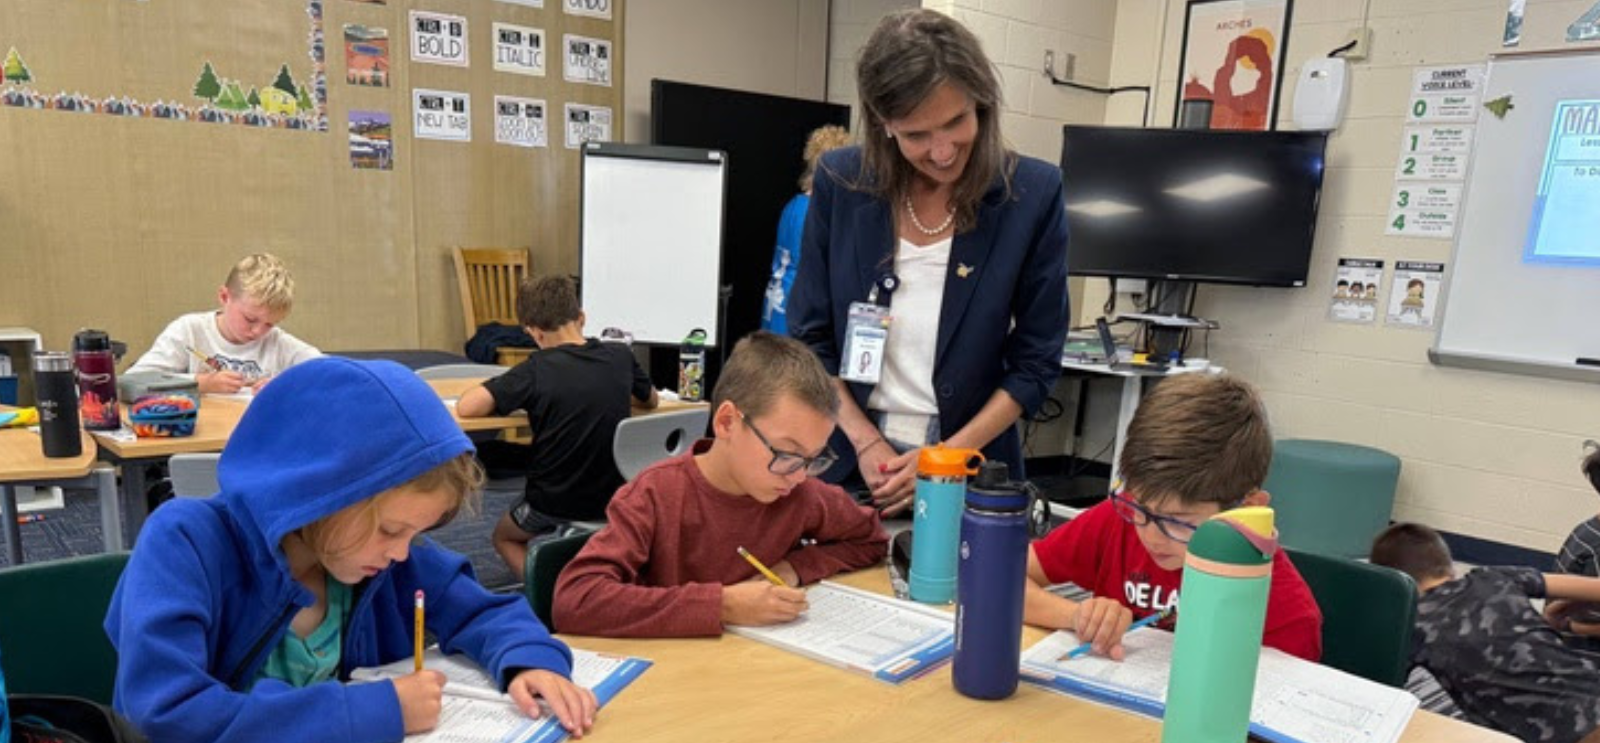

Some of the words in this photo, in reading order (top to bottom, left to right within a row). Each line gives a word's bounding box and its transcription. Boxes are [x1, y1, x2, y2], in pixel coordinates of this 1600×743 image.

[415, 19, 440, 33] CTRL
[450, 22, 461, 36] B
[1217, 18, 1252, 30] ARCHES
[498, 30, 520, 44] CTRL
[419, 35, 461, 58] BOLD
[497, 46, 541, 67] ITALIC
[1432, 69, 1467, 80] CURRENT
[1421, 81, 1446, 91] VOICE
[420, 96, 443, 110] CTRL
[452, 98, 463, 112] T
[1413, 99, 1427, 117] 0
[418, 113, 442, 127] NEW
[448, 115, 468, 130] TAB
[1563, 105, 1600, 135] MA
[1410, 134, 1419, 151] 1
[1403, 157, 1416, 174] 2
[1397, 190, 1409, 207] 3
[1392, 214, 1406, 230] 4
